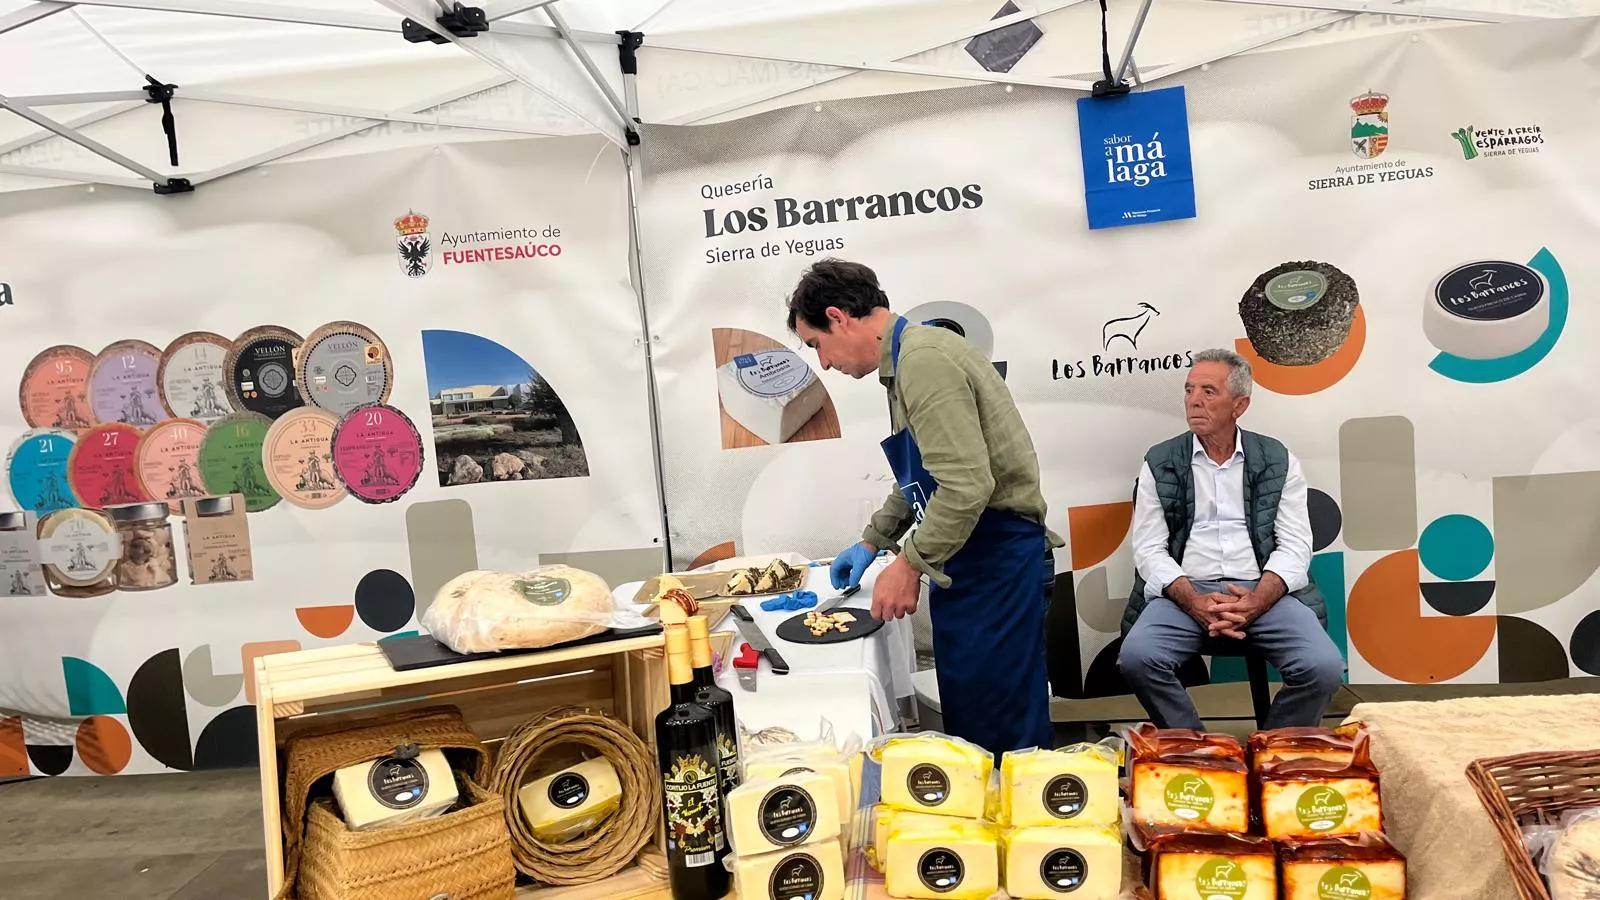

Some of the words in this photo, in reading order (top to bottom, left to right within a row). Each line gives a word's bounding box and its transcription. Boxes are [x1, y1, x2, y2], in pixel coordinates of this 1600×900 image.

[1104, 134, 1132, 145] sabor
[1475, 128, 1505, 138] VENTE
[1104, 146, 1113, 156] a
[1114, 132, 1166, 164] má
[1483, 150, 1506, 158] SIERRA
[1106, 158, 1168, 187] laga
[1335, 161, 1394, 174] Ayuntamiento
[1394, 159, 1406, 168] de
[701, 174, 774, 200] Quesería
[1308, 176, 1354, 190] SIERRA
[1357, 174, 1375, 185] DE
[1378, 167, 1434, 182] YEGUAS
[702, 206, 769, 238] Los
[774, 184, 984, 228] Barrancos
[440, 228, 537, 248] Ayuntamiento
[542, 224, 561, 238] de
[443, 242, 562, 264] FUENTESAÚCO
[706, 245, 756, 264] Sierra
[760, 242, 780, 258] de
[785, 236, 844, 256] Yeguas
[1450, 294, 1471, 306] Los
[1470, 278, 1528, 300] Barrancos
[1052, 359, 1086, 380] Los
[1092, 350, 1193, 378] Barrancos
[365, 412, 382, 426] 20
[39, 439, 53, 453] 21
[102, 432, 119, 446] 27
